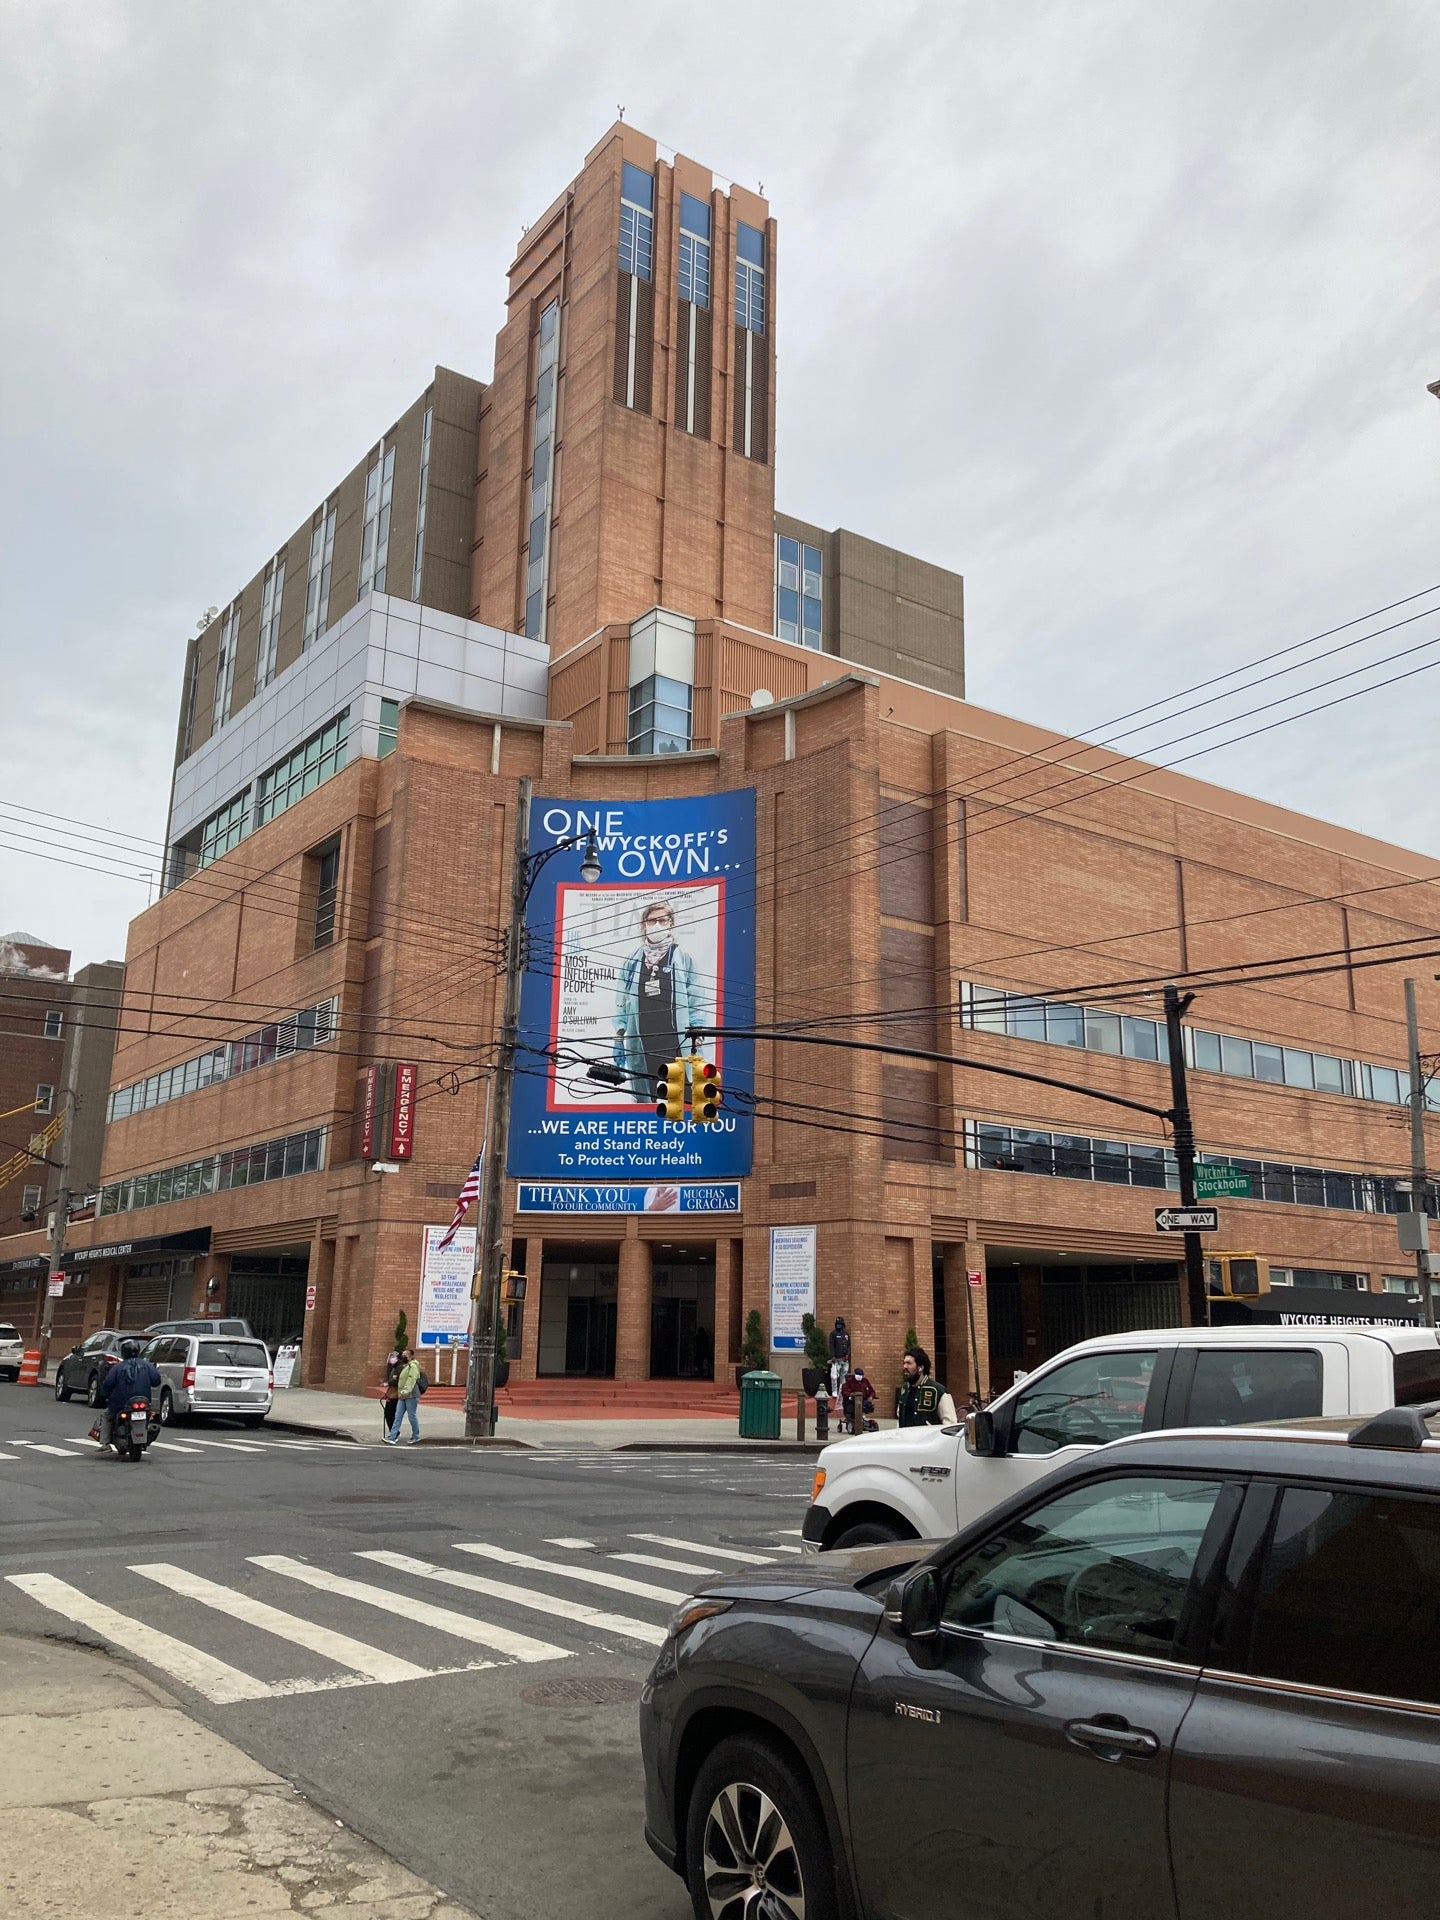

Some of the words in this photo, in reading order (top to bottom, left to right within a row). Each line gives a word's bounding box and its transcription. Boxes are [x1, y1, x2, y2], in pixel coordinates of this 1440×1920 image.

[543, 808, 624, 836] ONE
[597, 829, 728, 850] WYCKOFF'S
[618, 847, 740, 877] OWN...
[564, 956, 588, 967] MOST
[564, 968, 616, 980] INFLUENTIAL
[564, 981, 595, 993] PEOPLE
[563, 1007, 576, 1015] AMY
[364, 1069, 373, 1137] EMERGENCY
[398, 1068, 412, 1136] EMERGENCY
[574, 1120, 608, 1135] ARE
[613, 1120, 658, 1135] HERE
[663, 1119, 697, 1134] FOR
[702, 1118, 736, 1133] YOU
[574, 1139, 600, 1150] and
[604, 1138, 641, 1150] Stand
[645, 1138, 685, 1152] Ready
[558, 1154, 574, 1166] To
[578, 1153, 624, 1166] Protect
[628, 1154, 657, 1166] Your
[661, 1153, 702, 1165] Health
[1196, 1165, 1227, 1179] Wyckoff
[1198, 1179, 1247, 1192] Stockholm
[528, 1187, 588, 1203] THANK
[595, 1188, 630, 1203] YOU
[683, 1188, 725, 1199] MUCHAS
[551, 1202, 564, 1211] TO
[565, 1202, 584, 1211] OUR
[585, 1202, 638, 1211] COMMUNITY
[687, 1198, 736, 1210] GRACIAS
[1161, 1215, 1180, 1224] ONE
[1190, 1215, 1212, 1224] WAY
[1280, 1313, 1326, 1326] WYCKOFF
[1331, 1316, 1370, 1326] HEIGHTS
[1374, 1318, 1414, 1328] MEDICAL
[894, 1701, 941, 1724] HYBRID
